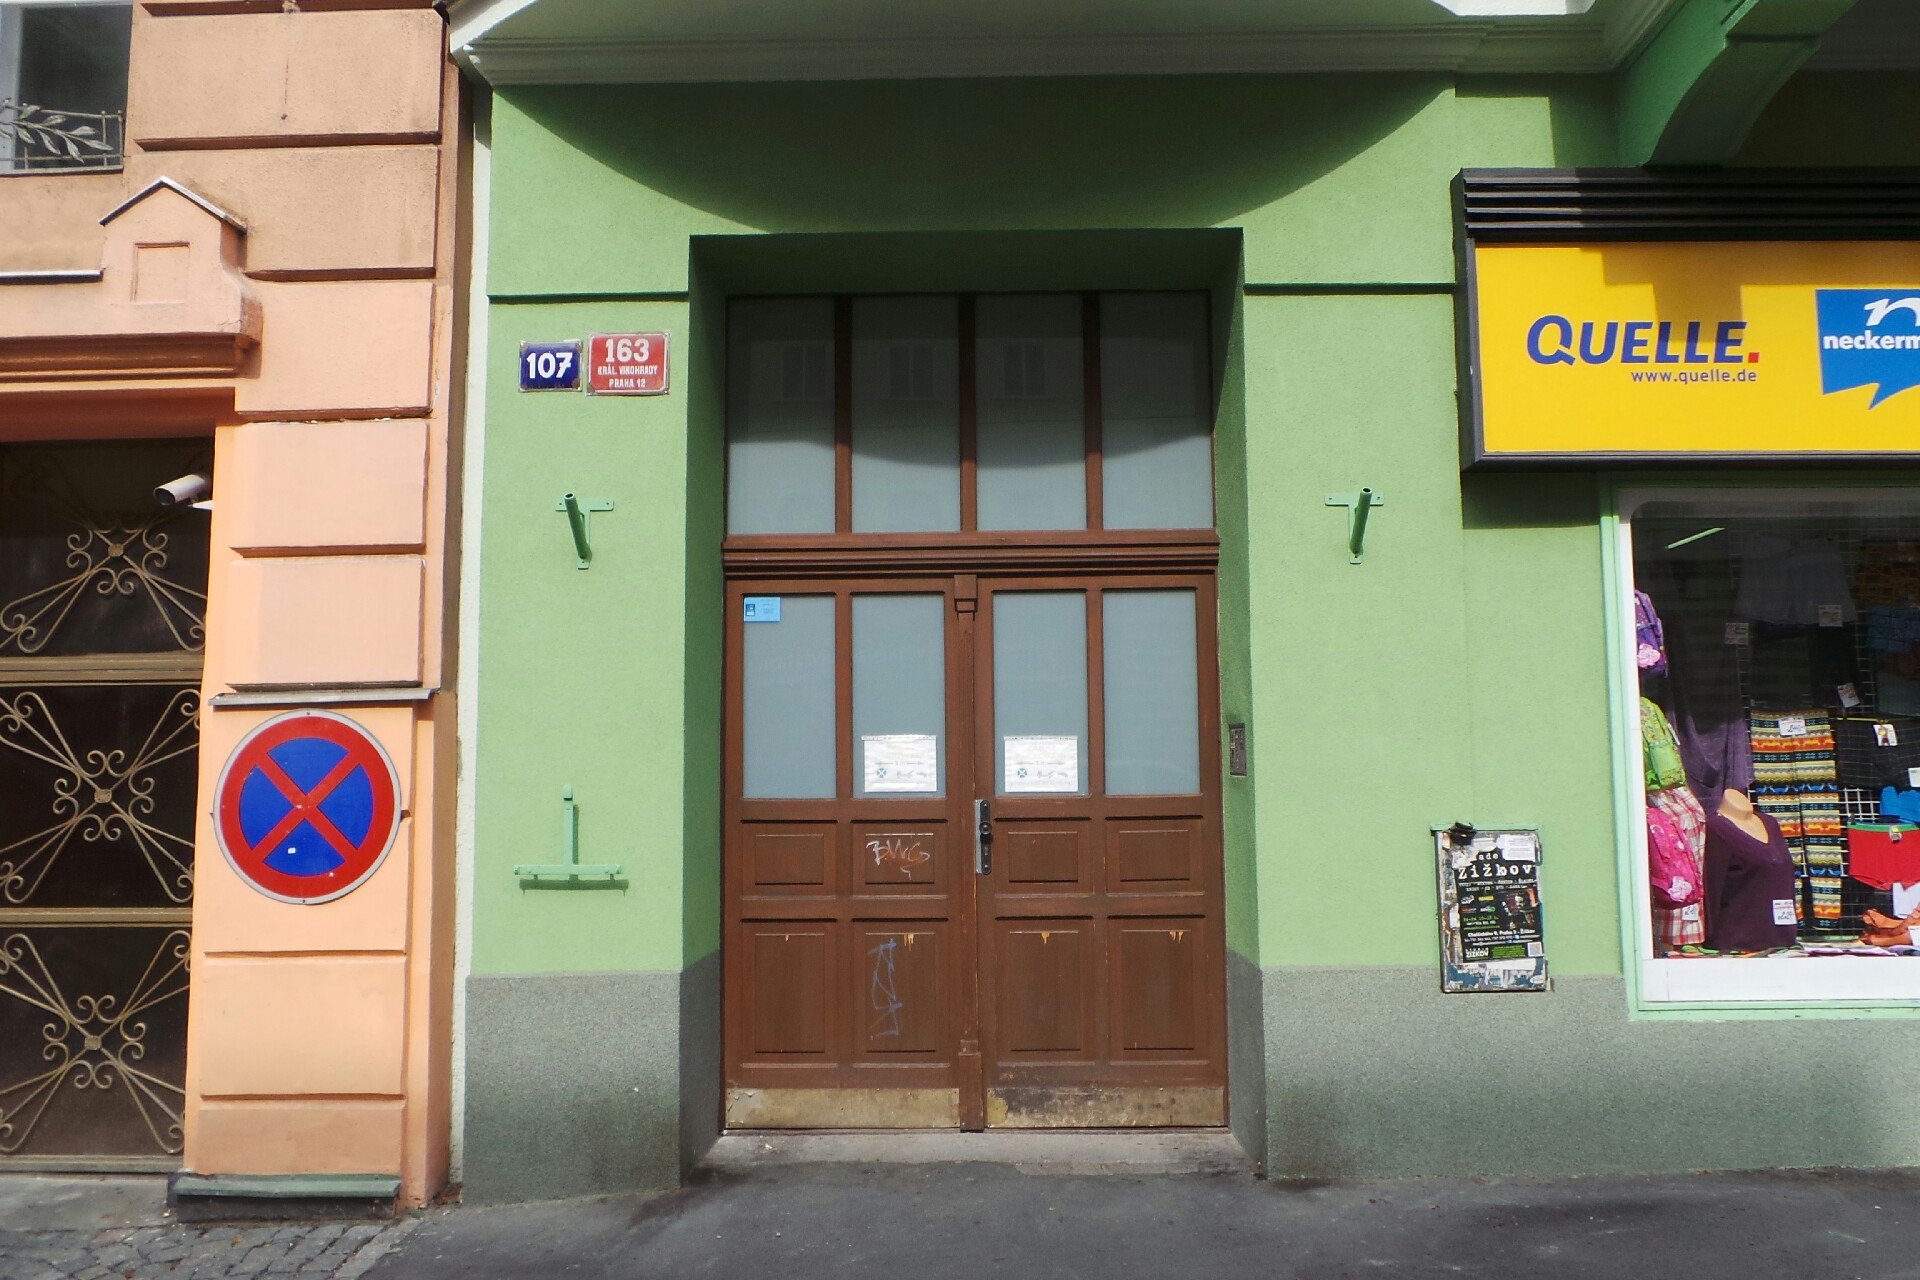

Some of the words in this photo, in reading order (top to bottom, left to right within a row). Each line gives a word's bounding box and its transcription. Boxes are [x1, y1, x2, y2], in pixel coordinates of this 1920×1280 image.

[1823, 329, 1920, 350] neckerm
[605, 338, 650, 363] 163
[526, 352, 573, 379] 107
[597, 364, 618, 375] KRÁL.
[619, 364, 658, 375] VINOHRADY
[608, 378, 635, 388] PRAHA
[636, 378, 646, 388] 12
[1630, 368, 1758, 385] www.quelle.de
